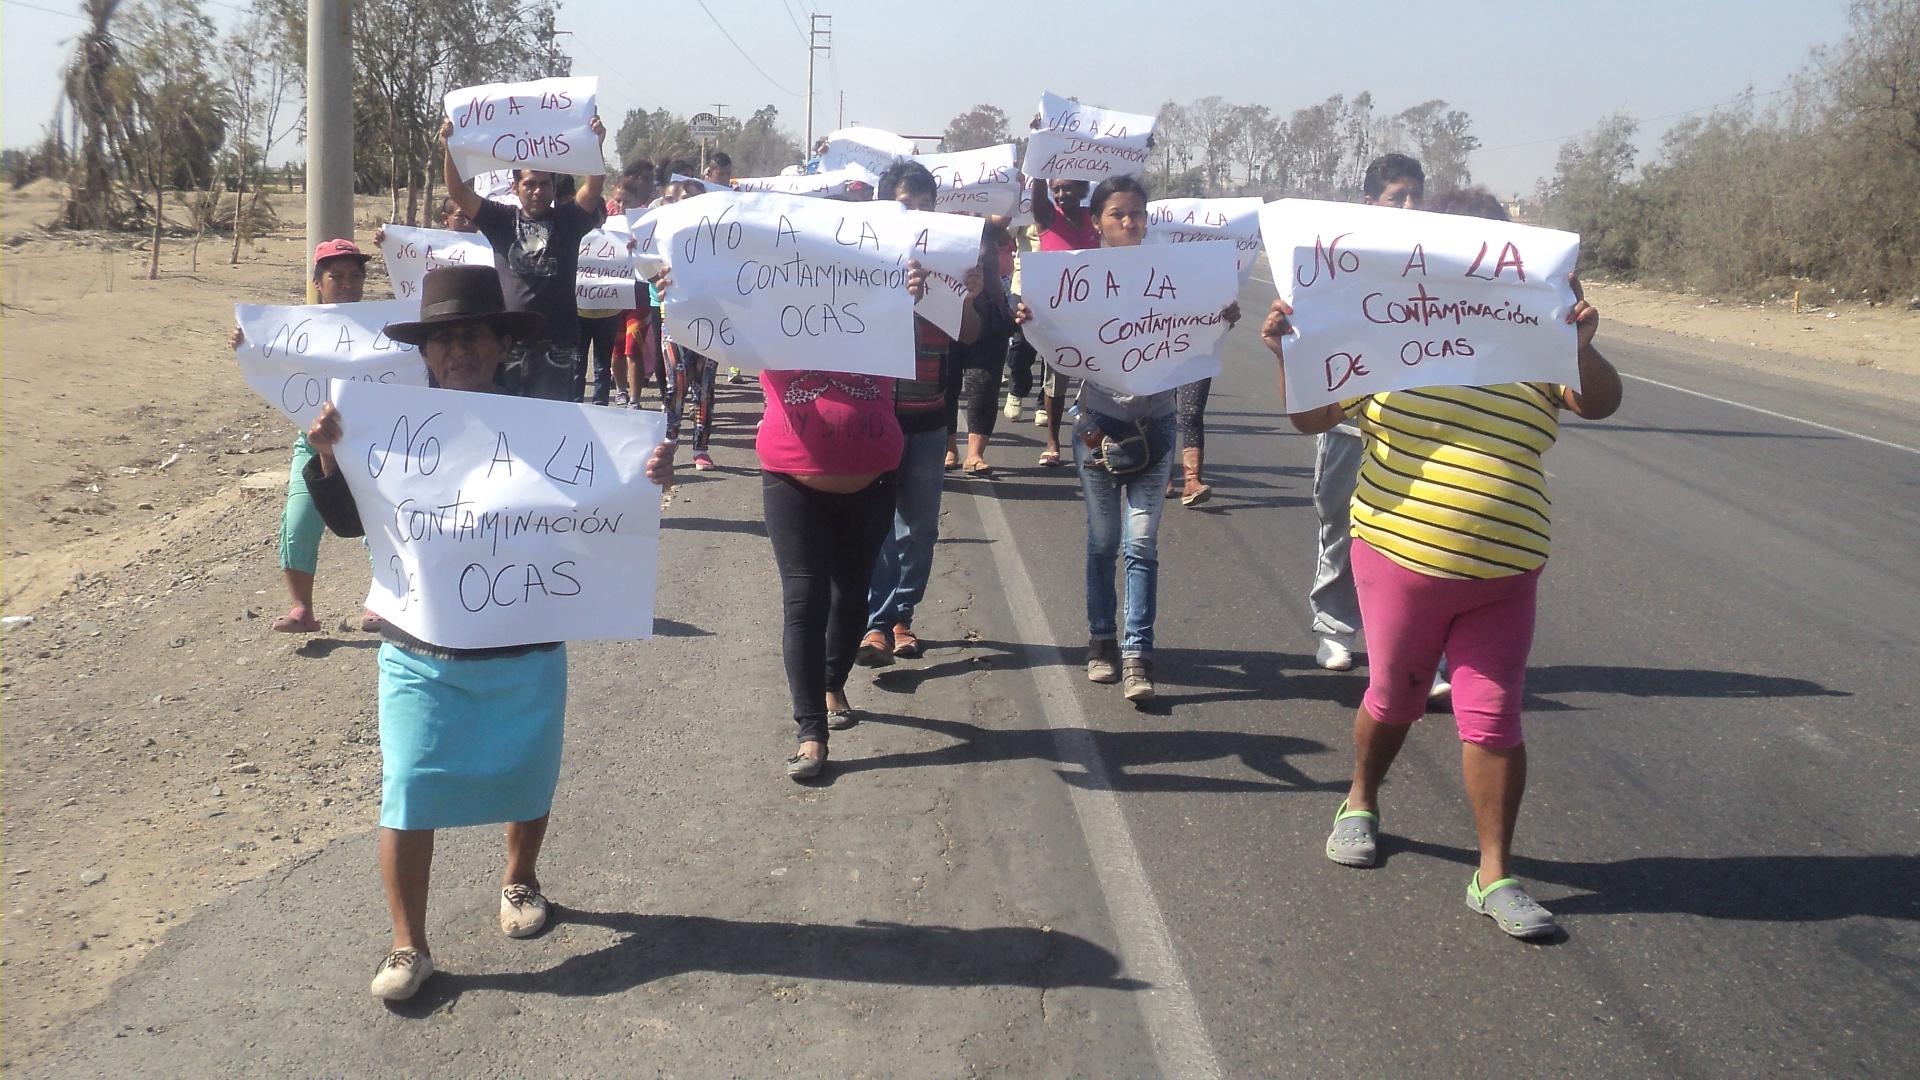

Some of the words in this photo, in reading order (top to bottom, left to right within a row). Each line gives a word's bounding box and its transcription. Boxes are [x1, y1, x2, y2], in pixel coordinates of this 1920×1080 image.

[509, 96, 524, 115] A
[541, 91, 572, 110] LAS
[692, 112, 718, 126] VIVERO
[1089, 119, 1099, 135] A
[1104, 123, 1128, 140] LA
[952, 171, 965, 189] A
[978, 161, 1010, 184] LAS
[1040, 154, 1112, 175] AGRICOLA
[1182, 210, 1195, 224] A
[1204, 211, 1229, 227] LA
[684, 204, 743, 264] NO
[776, 214, 802, 248] A
[835, 216, 880, 251] LA
[425, 244, 435, 261] A
[579, 242, 592, 257] A
[596, 241, 616, 258] LA
[1402, 243, 1427, 278] A
[1464, 240, 1526, 283] LA
[400, 280, 417, 297] DE
[1106, 270, 1121, 299] A
[1143, 267, 1177, 300] LA
[334, 324, 355, 353] A
[687, 317, 736, 351] DE
[780, 302, 866, 338] OCAS
[1055, 346, 1101, 372] DE
[1121, 333, 1191, 373] OCAS
[1324, 351, 1371, 392] DE
[1400, 337, 1476, 367] OCAS
[367, 411, 443, 479] NO
[487, 431, 515, 479] A
[544, 435, 595, 488] LA
[458, 560, 582, 613] OCAS
